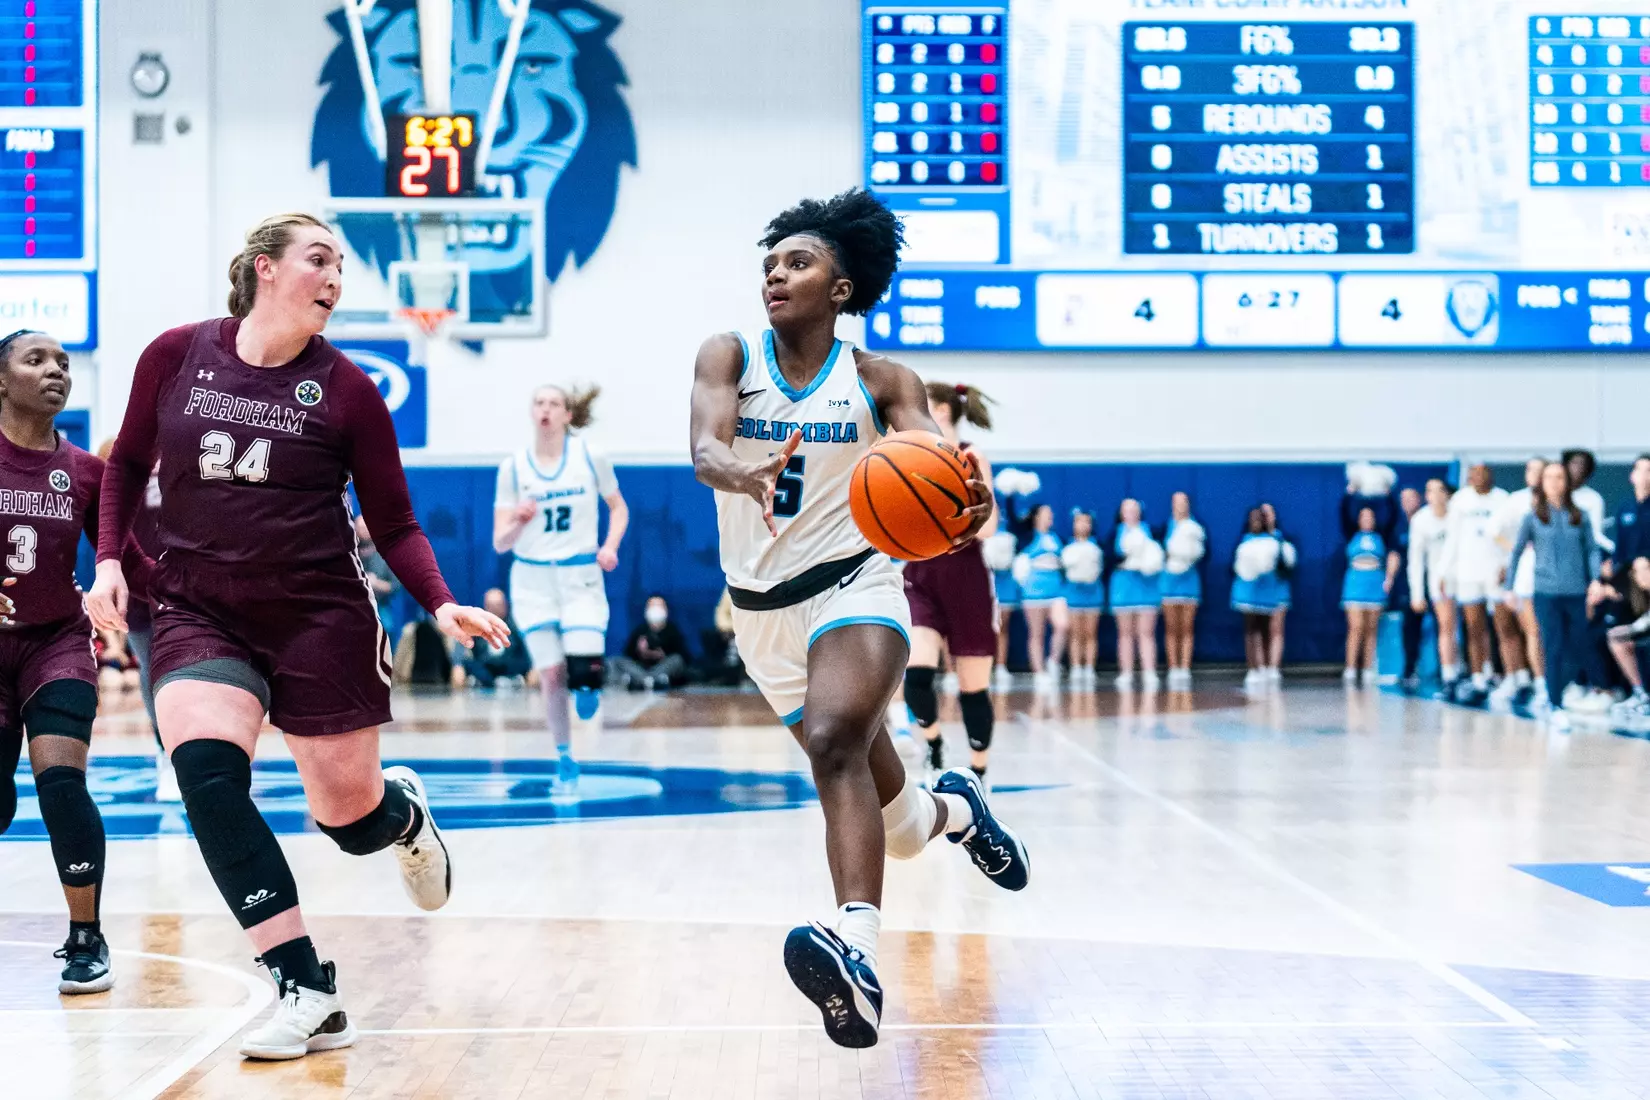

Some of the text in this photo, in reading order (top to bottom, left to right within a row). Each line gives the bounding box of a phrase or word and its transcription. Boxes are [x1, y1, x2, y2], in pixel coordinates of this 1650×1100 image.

[1242, 26, 1293, 54] FG%
[1234, 66, 1301, 93] 3FG%
[406, 116, 473, 147] 6:27
[1205, 104, 1331, 133] REBOUNDS
[400, 146, 460, 195] 27
[1217, 145, 1317, 173] ASSISTS
[1368, 145, 1382, 169] 1
[1225, 184, 1310, 212] STEALS
[1368, 184, 1382, 208] 1
[1154, 224, 1382, 251] 1 TURNOVERS 1
[1133, 298, 1156, 322] 4
[1380, 298, 1403, 321] 4
[184, 387, 307, 435] FORDHAM
[199, 430, 272, 482] 24
[769, 452, 806, 518] 5
[543, 505, 572, 533] 12
[6, 524, 38, 574] 3
